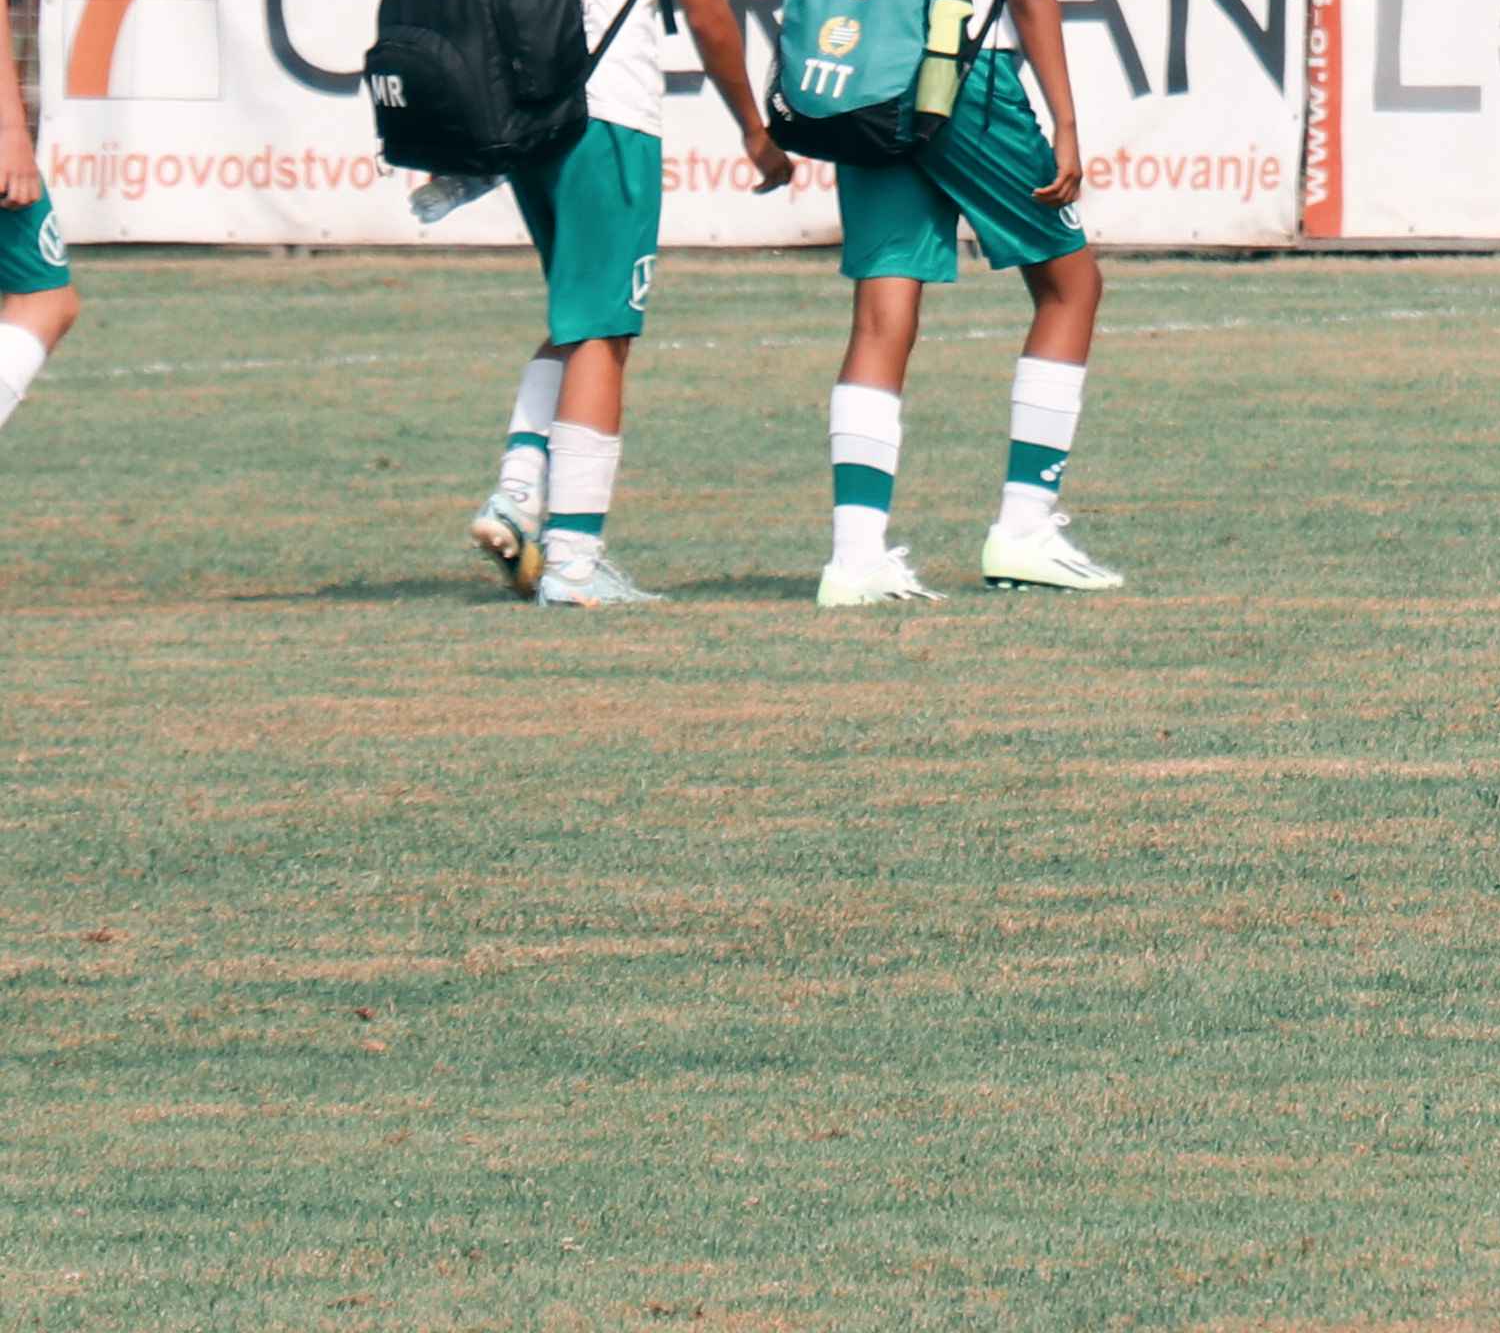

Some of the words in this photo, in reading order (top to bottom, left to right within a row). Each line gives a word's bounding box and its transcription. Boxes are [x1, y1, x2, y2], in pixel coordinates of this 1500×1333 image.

[370, 73, 408, 108] MR
[800, 58, 855, 99] TTT
[49, 143, 376, 201] knjigovodstvo
